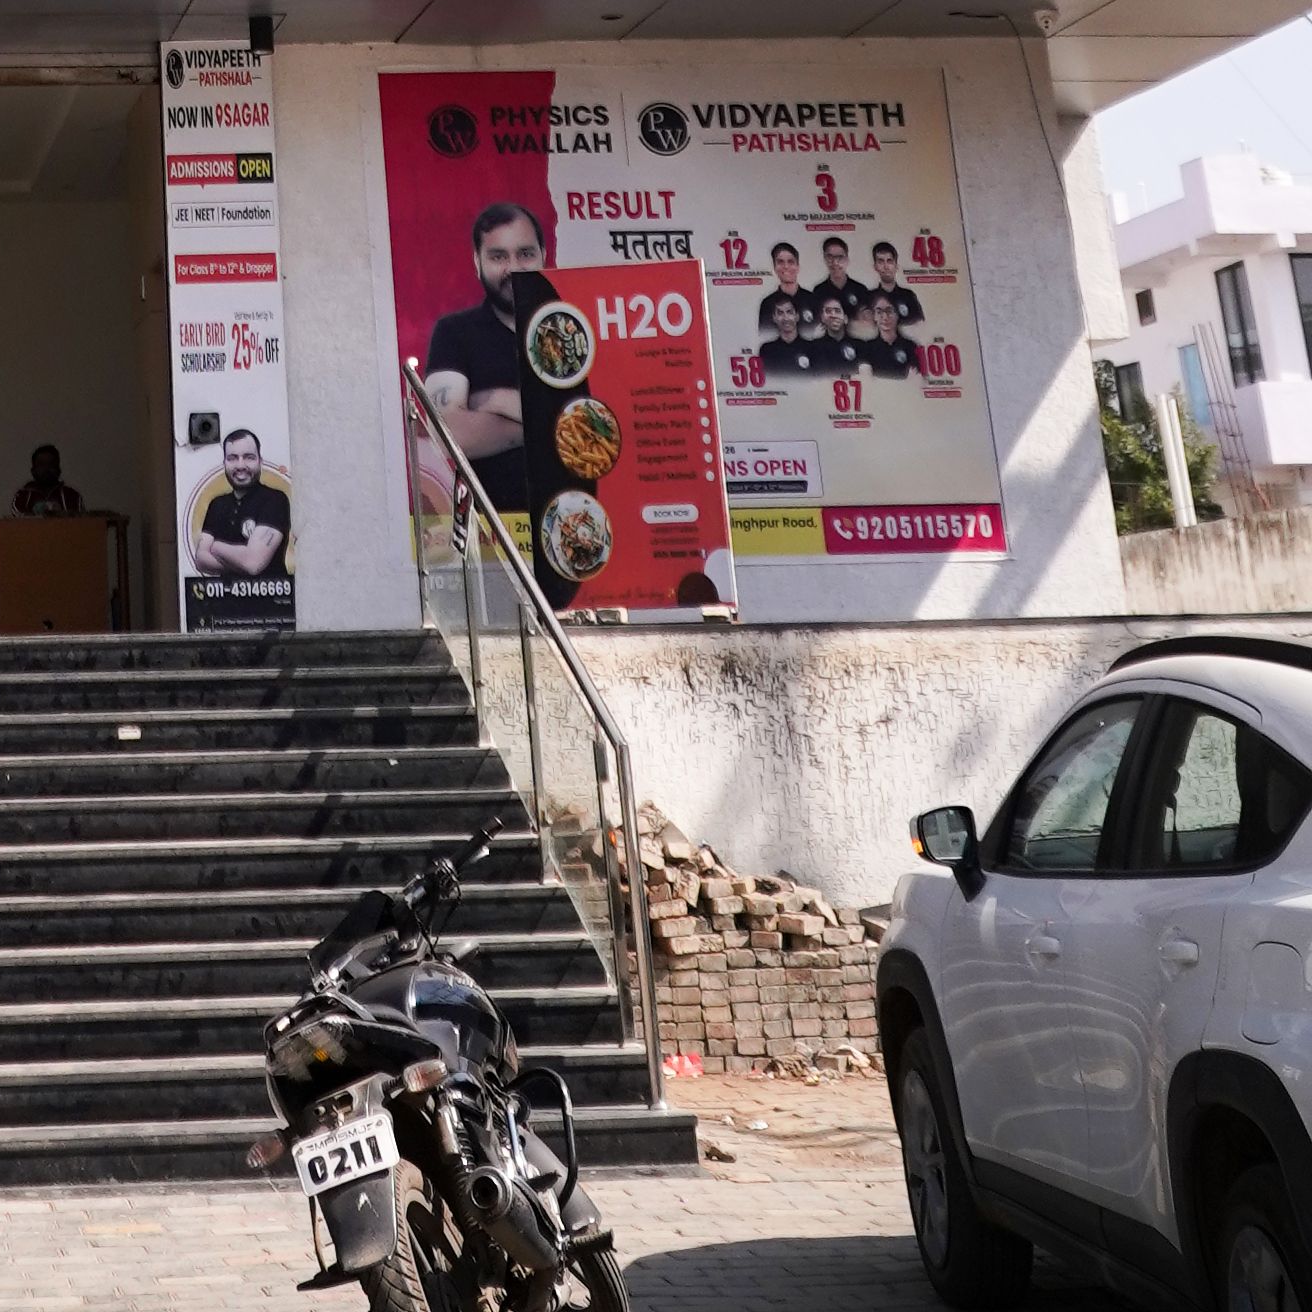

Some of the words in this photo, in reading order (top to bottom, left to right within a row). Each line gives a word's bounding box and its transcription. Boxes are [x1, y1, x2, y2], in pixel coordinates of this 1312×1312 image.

[199, 72, 252, 87] PATHSHALA
[168, 106, 199, 129] NOW
[201, 105, 214, 128] IN
[225, 102, 270, 127] SAGAR
[491, 105, 610, 126] PHYSICS
[692, 103, 905, 129] VIDYAPEETH
[492, 133, 613, 154] WALLAH
[732, 133, 881, 153] PATHSHALA
[170, 160, 235, 179] ADMISSIONS
[239, 159, 270, 177] OPEN
[815, 173, 838, 212] 3
[175, 209, 189, 222] JEE
[195, 208, 215, 221] NEET
[221, 207, 271, 220] Foundation
[567, 191, 676, 220] RESULT
[609, 230, 693, 260] मतलब
[719, 238, 750, 270] 12
[912, 236, 945, 268] 48
[597, 292, 693, 342] H2O
[180, 323, 203, 347] EARLY
[206, 322, 226, 346] BIRD
[231, 323, 263, 370] 25%
[265, 338, 279, 364] OFF
[181, 351, 226, 373] SCHOLARSHIP
[730, 356, 766, 388] 58
[915, 344, 961, 377] 100
[833, 380, 862, 412] 87
[754, 459, 807, 476] OPEN
[783, 517, 817, 528] Road,
[857, 515, 993, 540] 9205115570
[206, 581, 291, 599] 011-43146669
